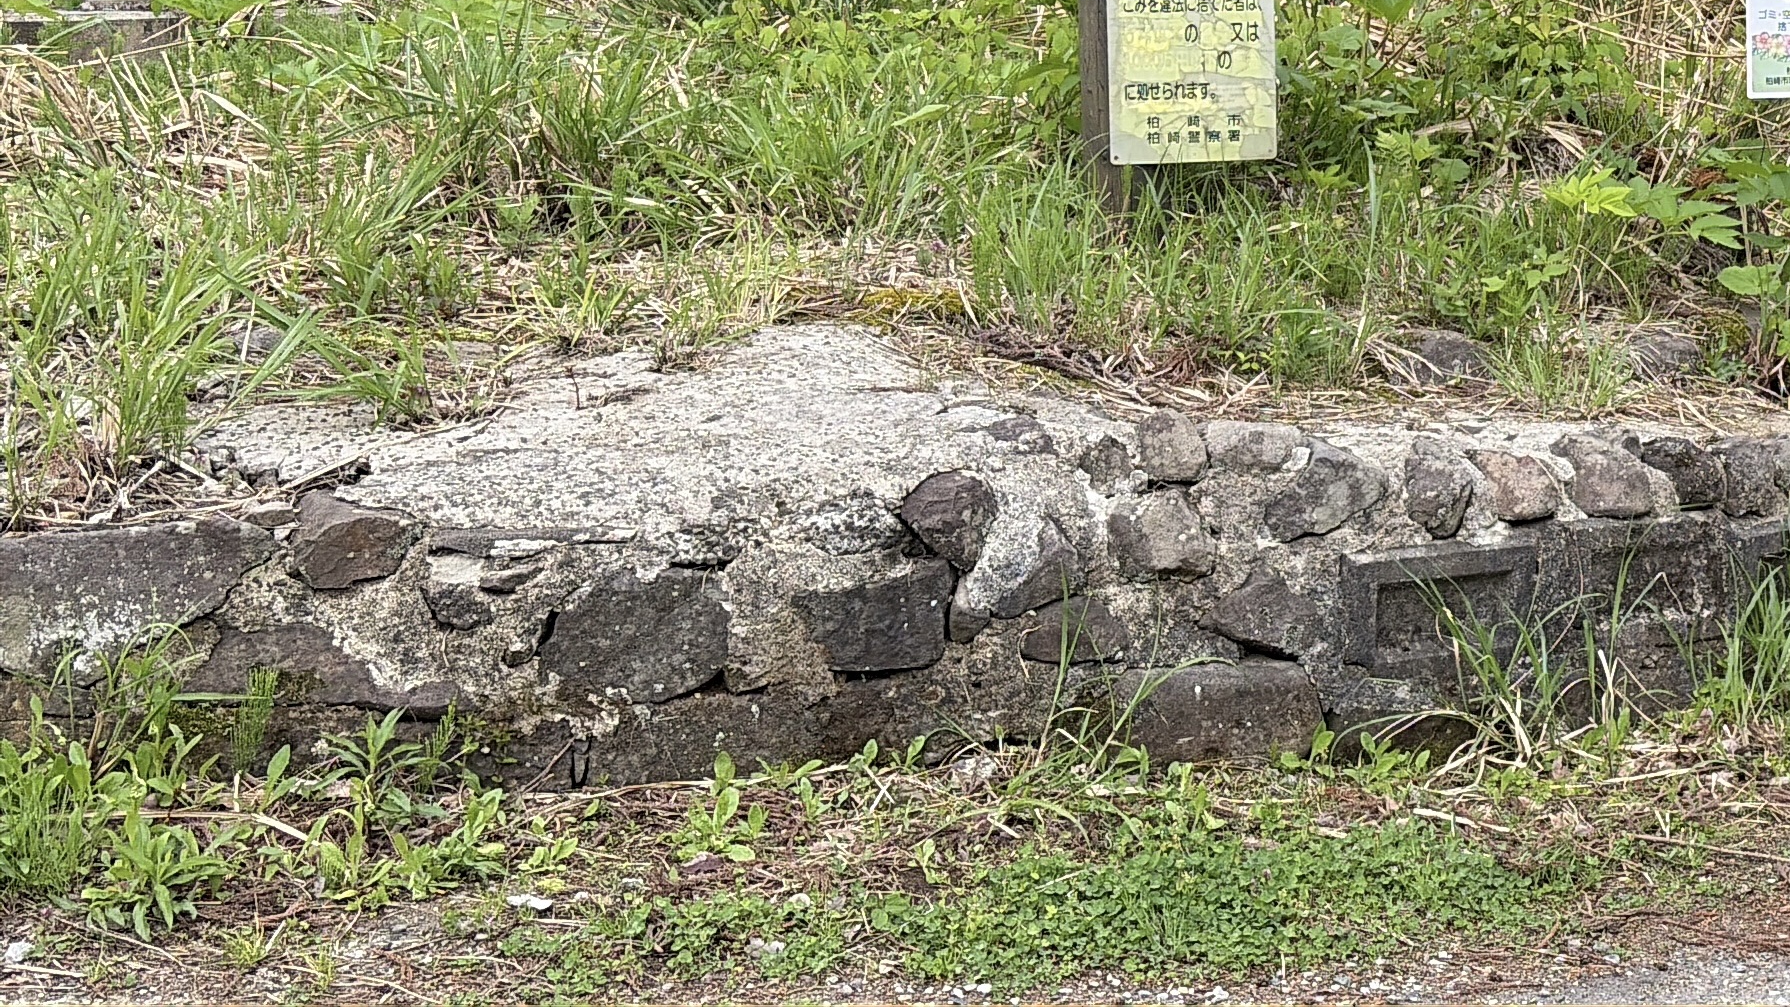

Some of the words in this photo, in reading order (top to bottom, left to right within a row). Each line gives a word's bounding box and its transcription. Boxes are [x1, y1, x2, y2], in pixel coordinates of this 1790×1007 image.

[1185, 24, 1198, 43] の
[1230, 21, 1260, 43] 又は
[1218, 51, 1232, 70] の
[1125, 82, 1217, 101] に処せられます。
[1146, 130, 1241, 145] 柏崎警察署
